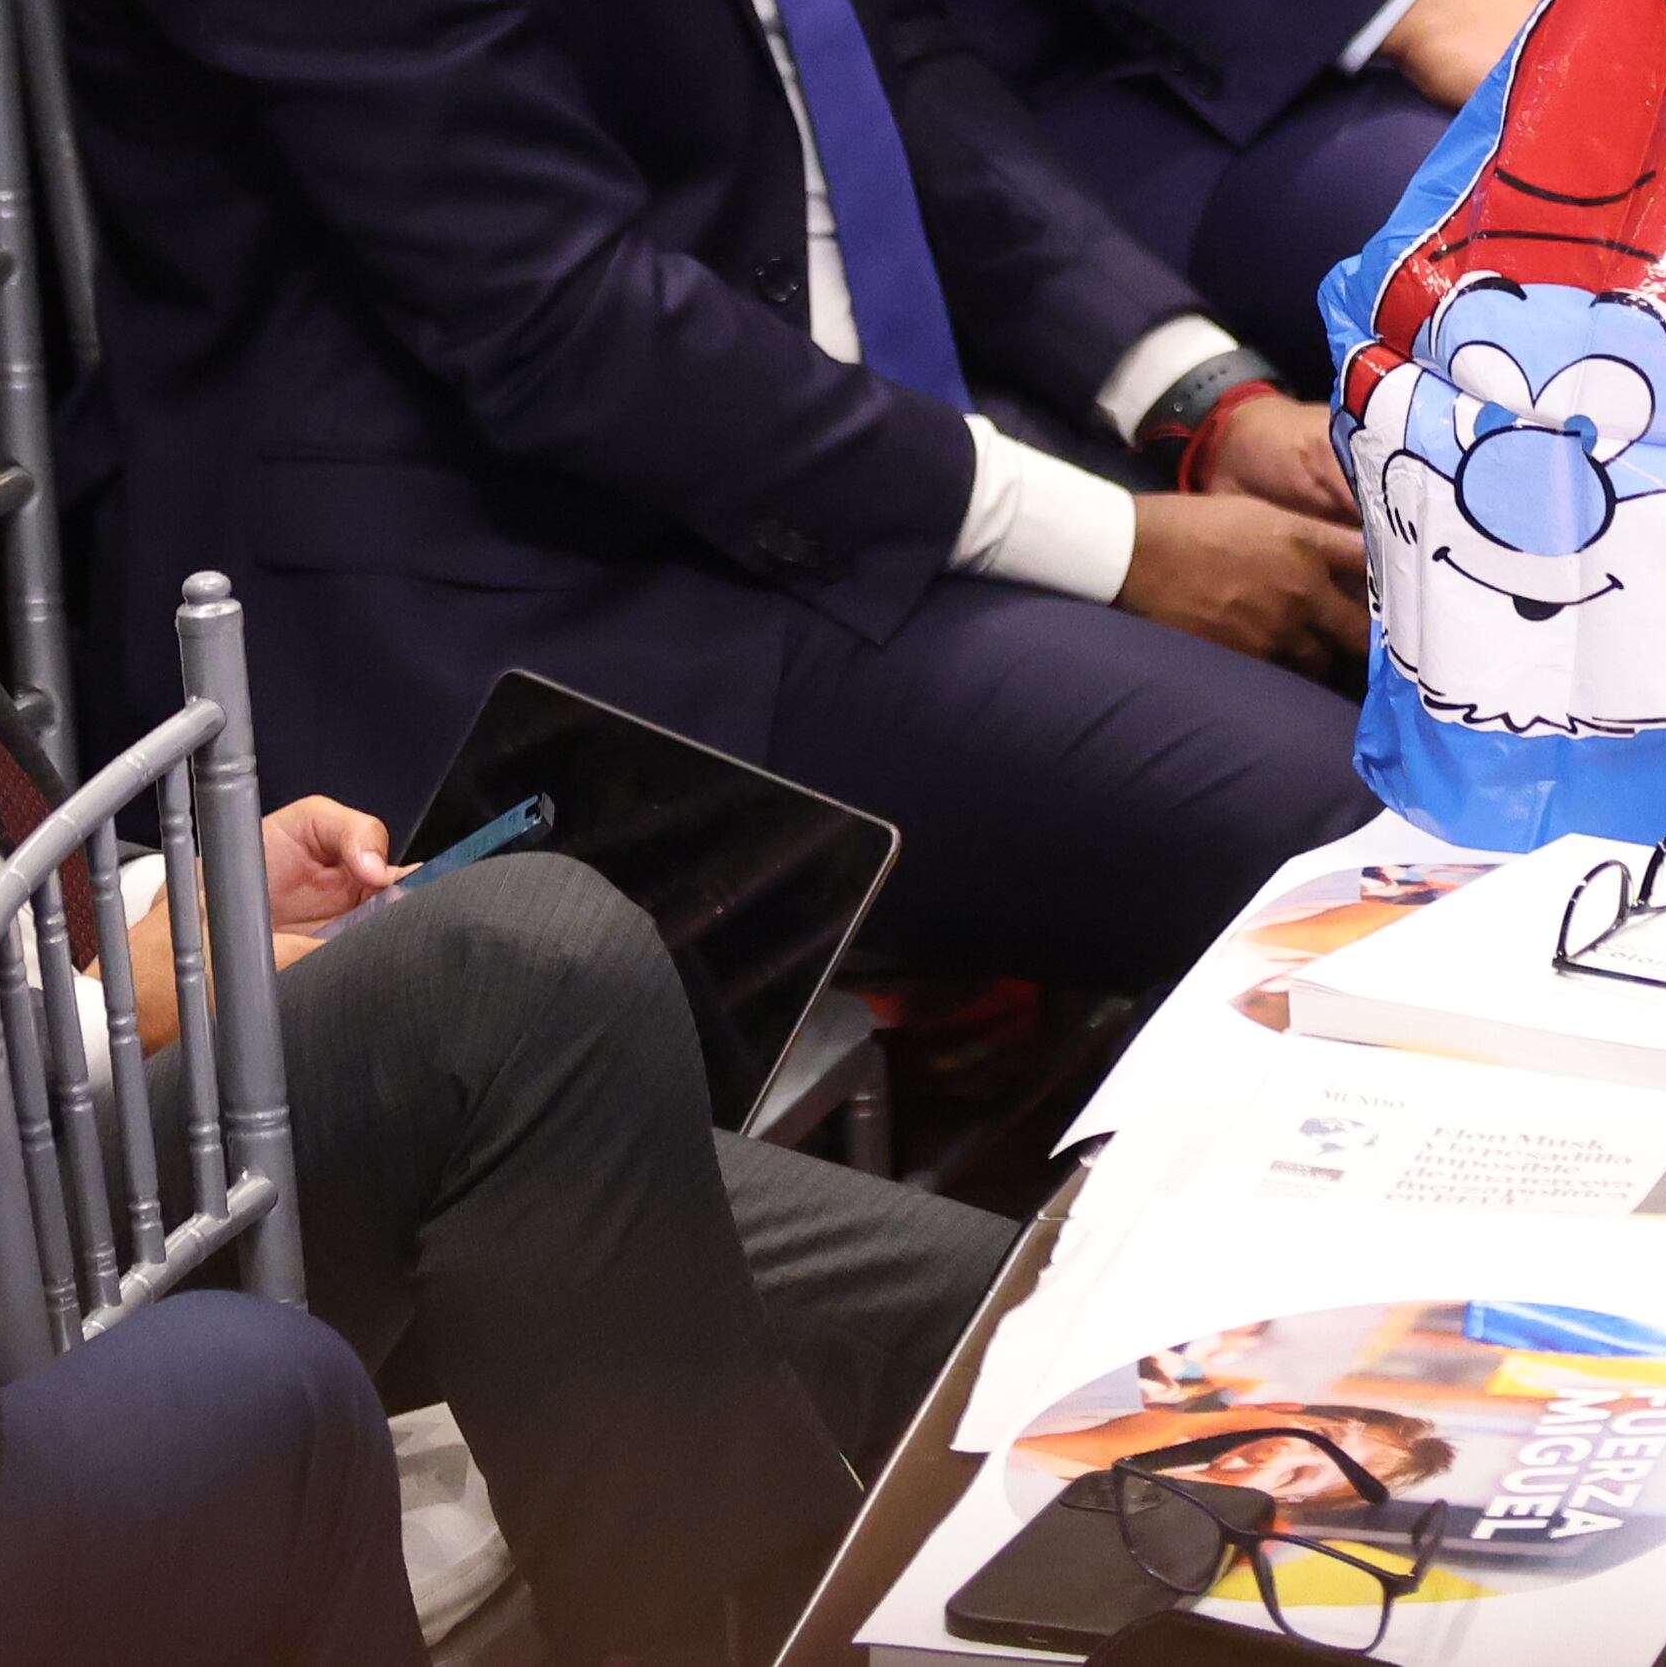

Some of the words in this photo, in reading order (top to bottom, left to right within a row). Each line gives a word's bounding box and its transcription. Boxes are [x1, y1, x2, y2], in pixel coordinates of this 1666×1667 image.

[1321, 1089, 1406, 1108] MUNDO
[1433, 1126, 1508, 1144] Elon
[1511, 1133, 1609, 1152] Musk
[1480, 1146, 1634, 1167] pesadilla
[1470, 1387, 1624, 1540] MIGUEL
